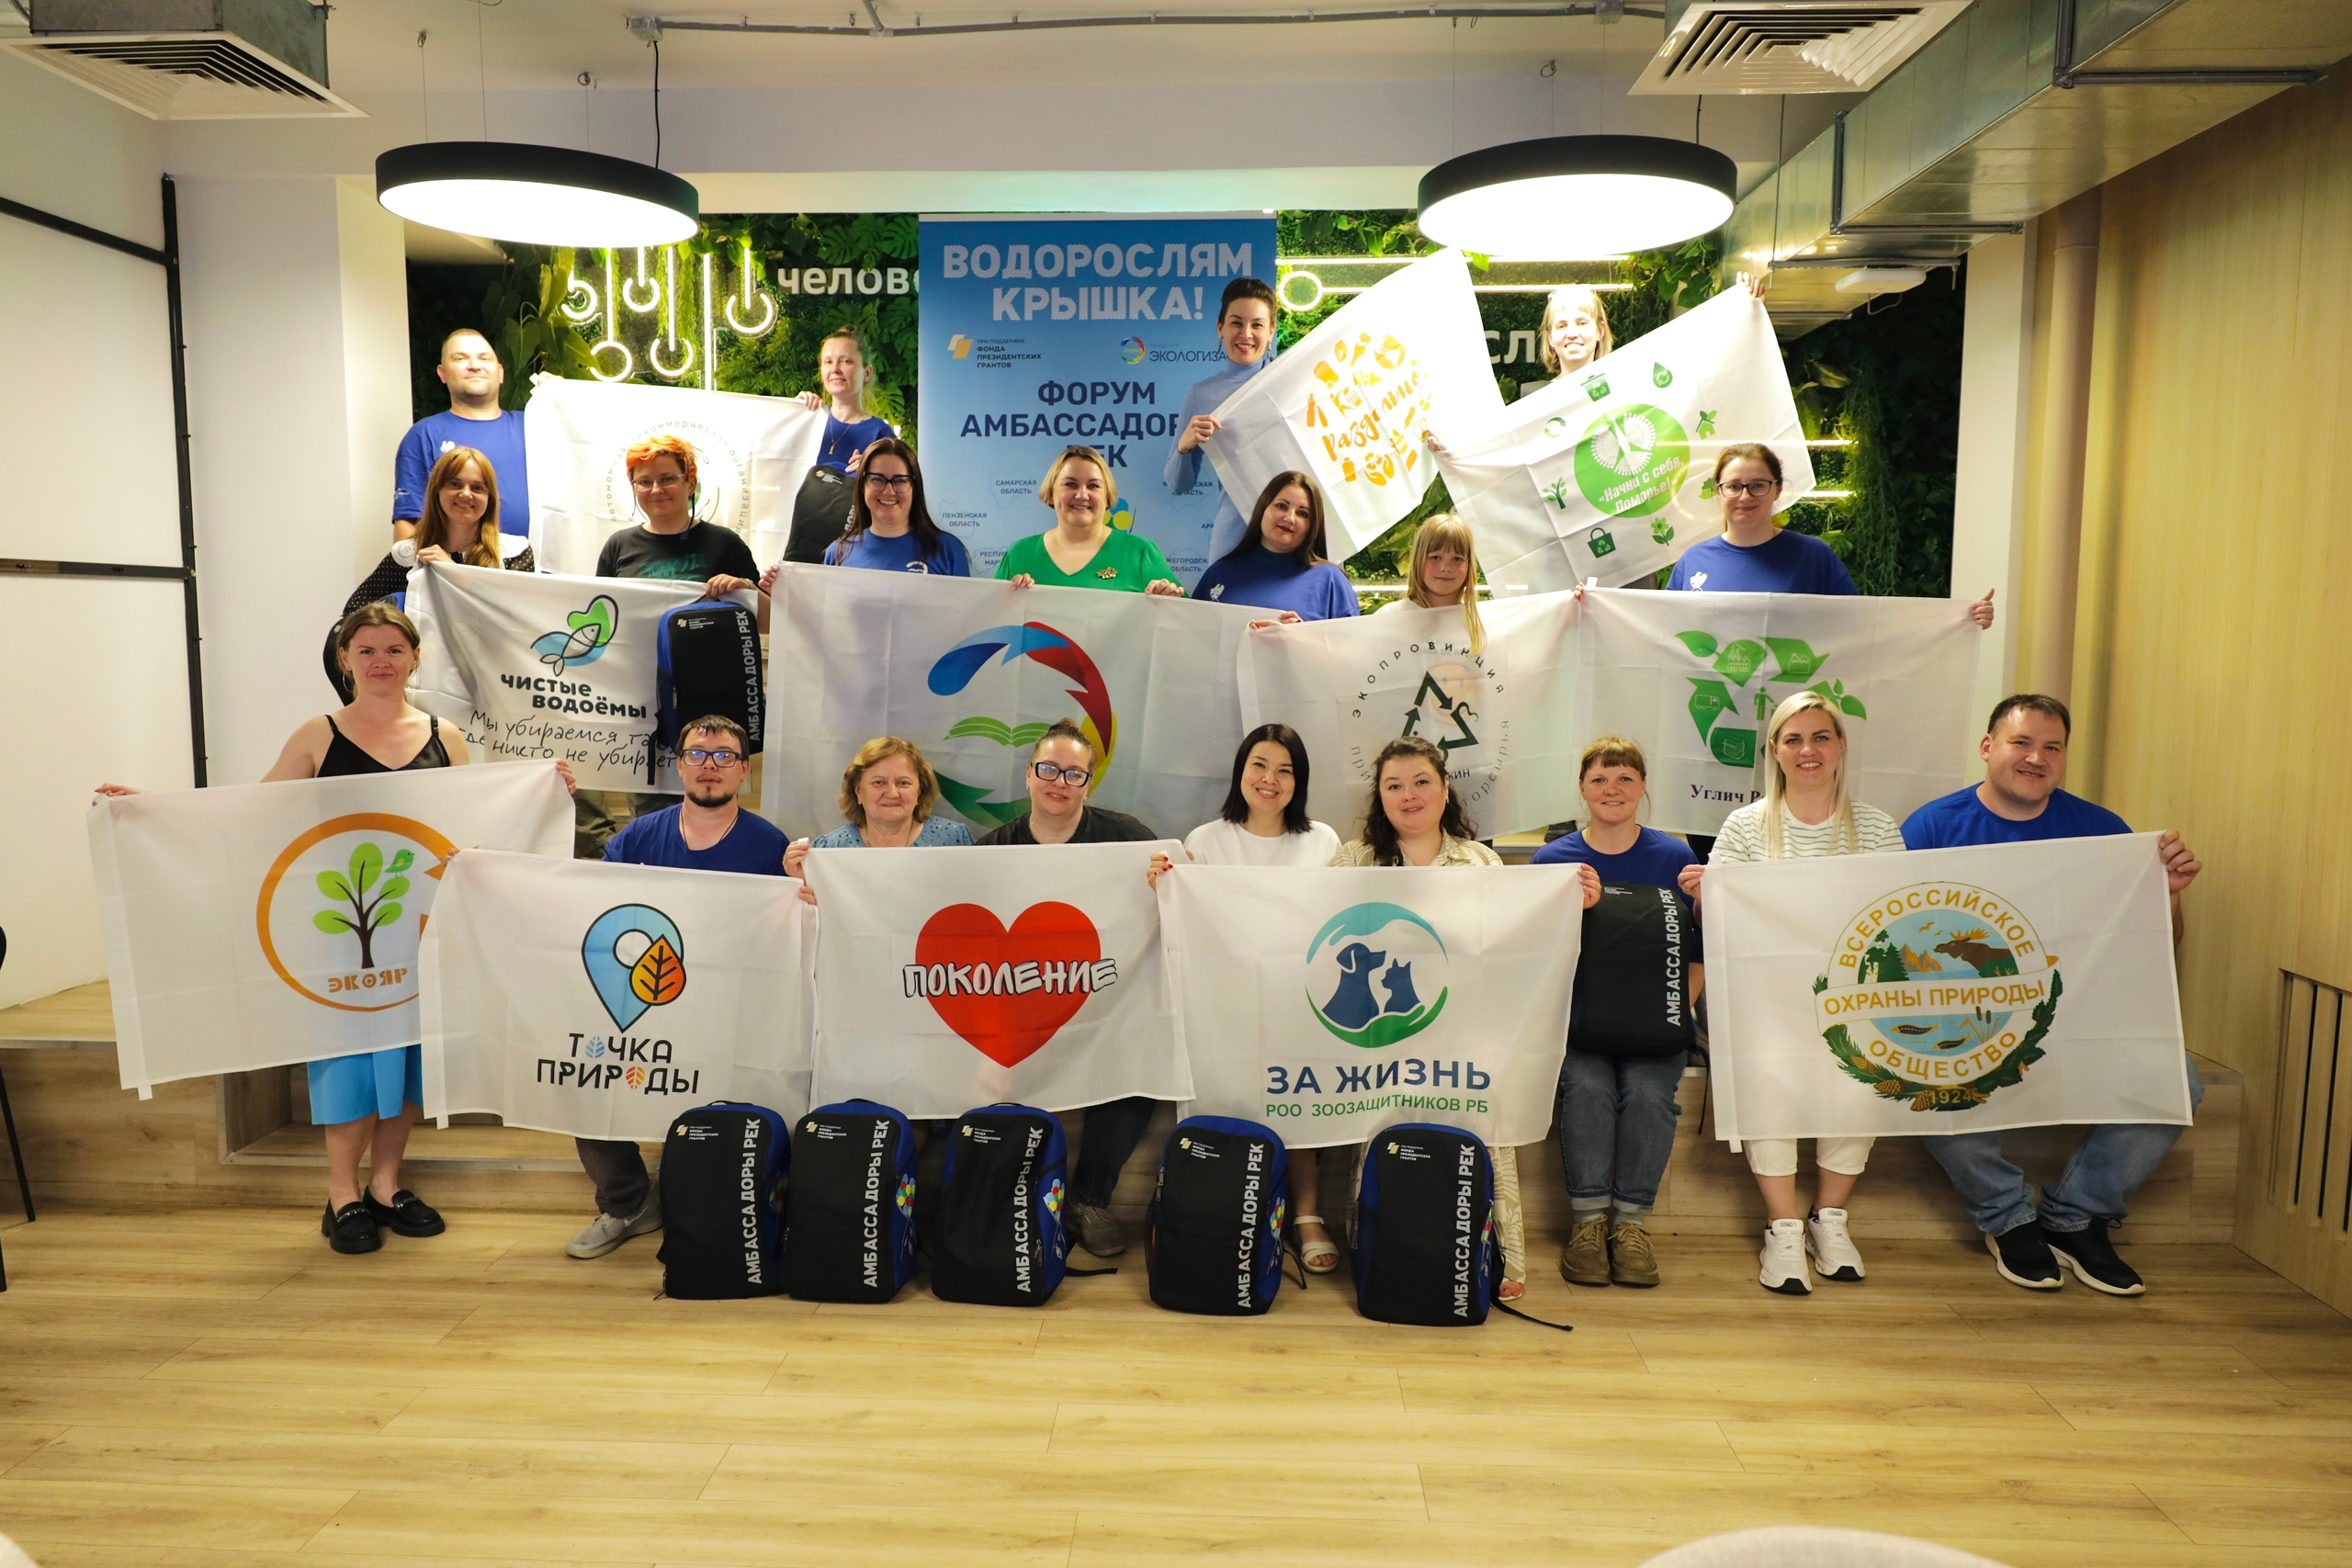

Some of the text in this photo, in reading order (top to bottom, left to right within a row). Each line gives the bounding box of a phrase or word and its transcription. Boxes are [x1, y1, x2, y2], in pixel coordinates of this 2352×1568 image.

[943, 242, 1252, 279] ВОДОРОСЛЯМ
[777, 267, 919, 295] челов
[992, 286, 1204, 321] КРЫШКА!
[1149, 351, 1227, 362] ЭКОЛОГИЗА
[1037, 380, 1155, 406] ФОРУМ
[960, 412, 1180, 440] АМБАССАДОР
[735, 611, 761, 741] АМБАССАДОРЫ РЕК
[1352, 641, 1504, 718] ЭКОПРОВИНЦИЯ
[469, 709, 498, 732] Мы
[505, 714, 618, 747] убираемся
[492, 739, 555, 759] никто
[565, 748, 588, 762] не
[596, 743, 677, 775] убирет
[1690, 784, 1745, 804] Углич
[1838, 888, 2035, 968] ВСЕРОССИЙСКОЕ
[1657, 887, 1681, 1027] АМБАССАДОРЫ РЕК
[327, 967, 408, 993] ЭКОЯР
[901, 958, 1118, 998] ПОКОЛЕНИЕ
[1824, 979, 2045, 1015] ОХРАНЫ ПРИРОДЫ
[1869, 1031, 2017, 1080] ОБЩЕСТВО
[1266, 1057, 1492, 1095] ЗА ЖИЗНЬ
[1266, 1094, 1489, 1118] РОО ЗООЗАЩИТНИКОВ РБ
[1929, 1088, 1973, 1104] 1924
[741, 1118, 763, 1285] АМБАССАДОРЫ РЕК
[863, 1119, 890, 1289] АМБАССАДОРЫ РЕК
[1013, 1126, 1044, 1293] АМБАССАДОРЫ РЕК
[1238, 1143, 1264, 1309] АМБАССАДОРЫ РЕК
[1453, 1144, 1476, 1318] АМБАССАДОРЫ РЕК
